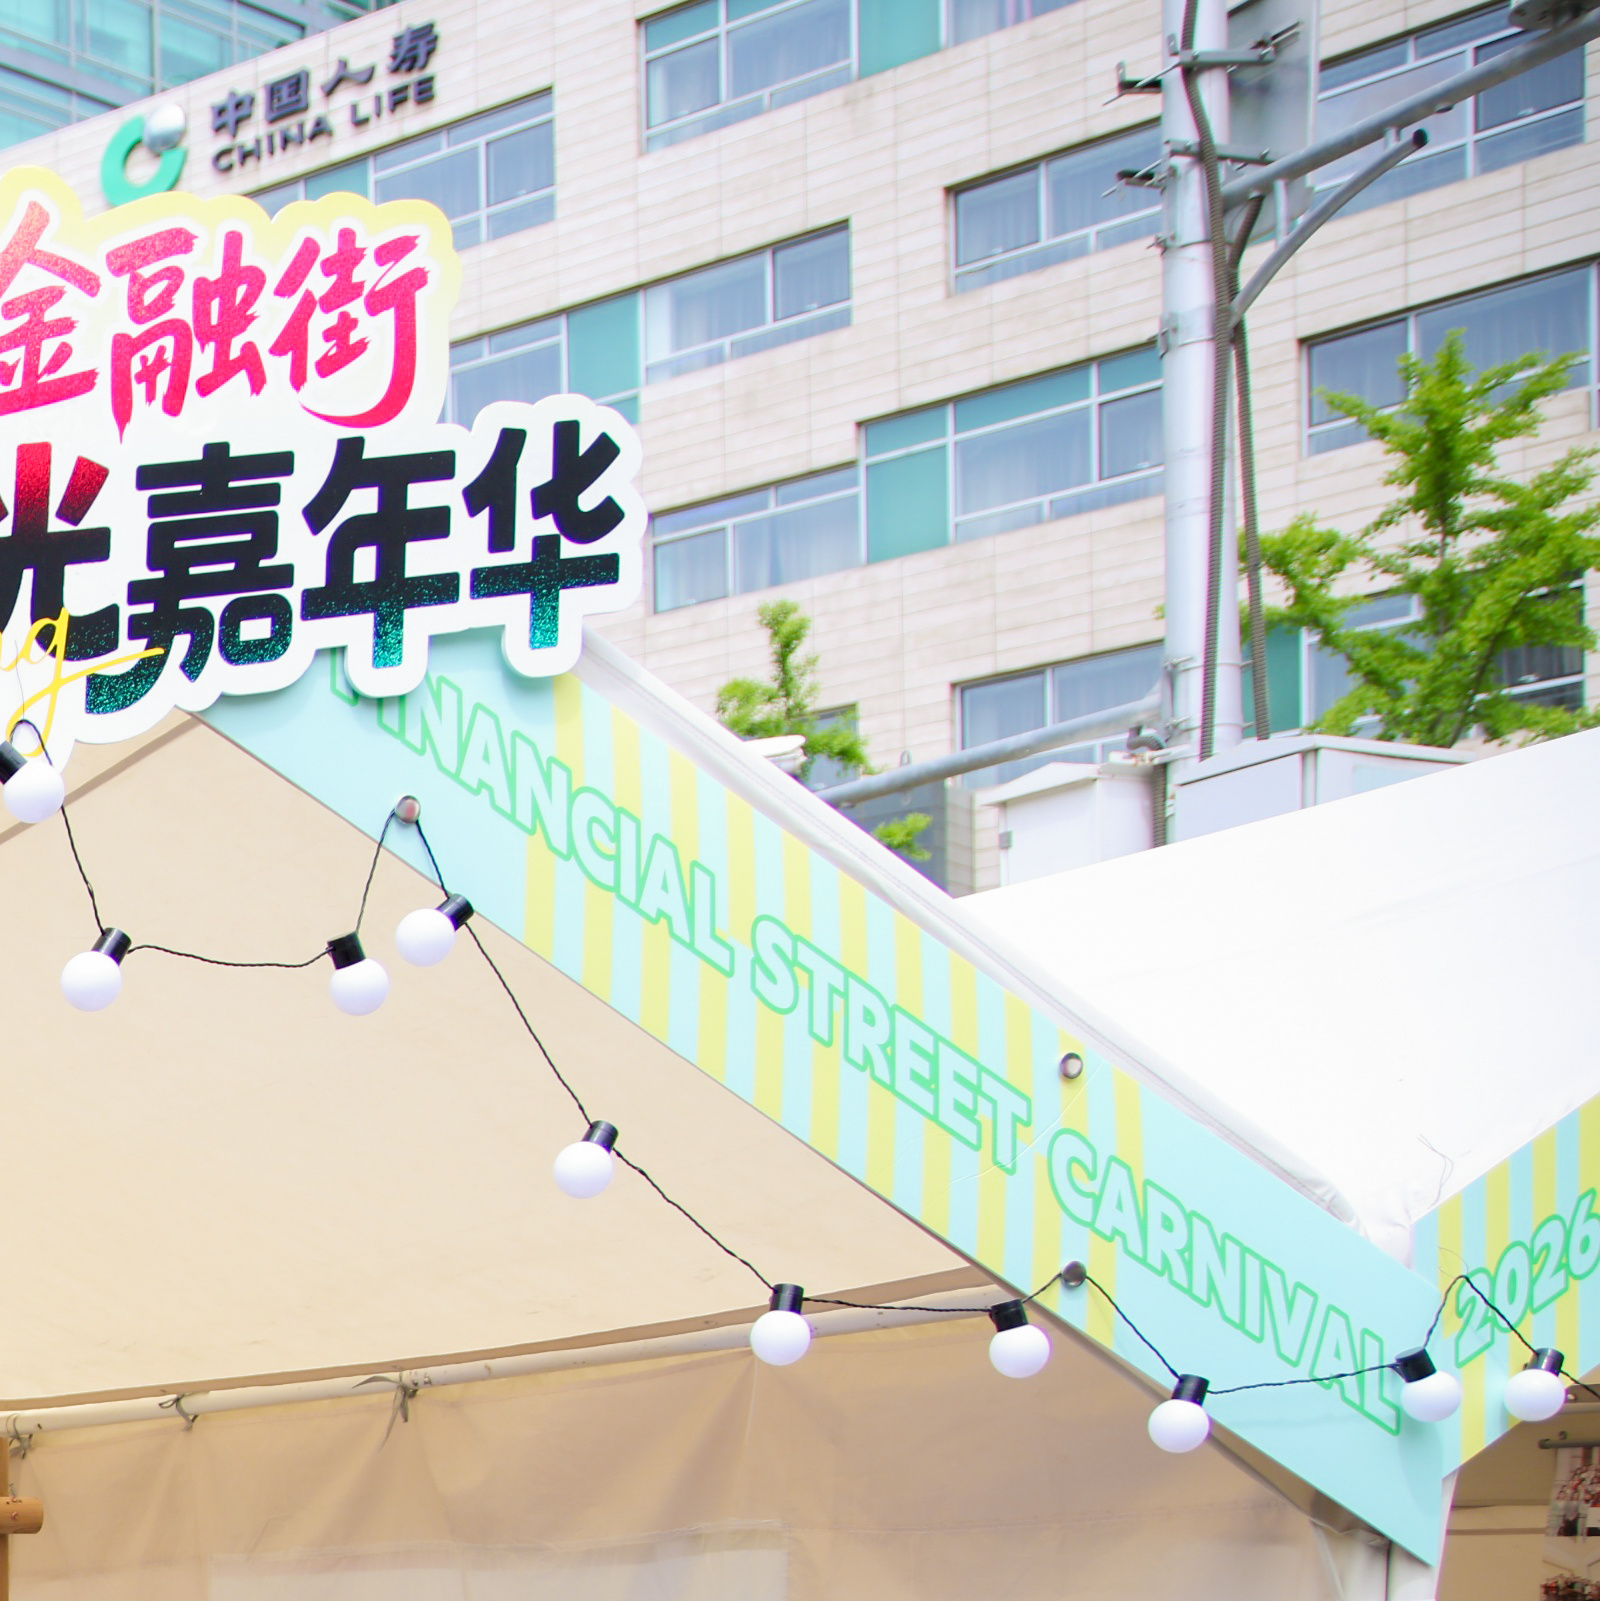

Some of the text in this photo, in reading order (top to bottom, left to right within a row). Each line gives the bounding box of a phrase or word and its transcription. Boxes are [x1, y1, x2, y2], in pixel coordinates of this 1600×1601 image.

[210, 20, 438, 138] 中国人寿
[211, 76, 436, 173] CHINA LIFE
[330, 645, 1402, 1437] NANCIAL STREET CARNIVAL
[1454, 1186, 1600, 1369] 2026
